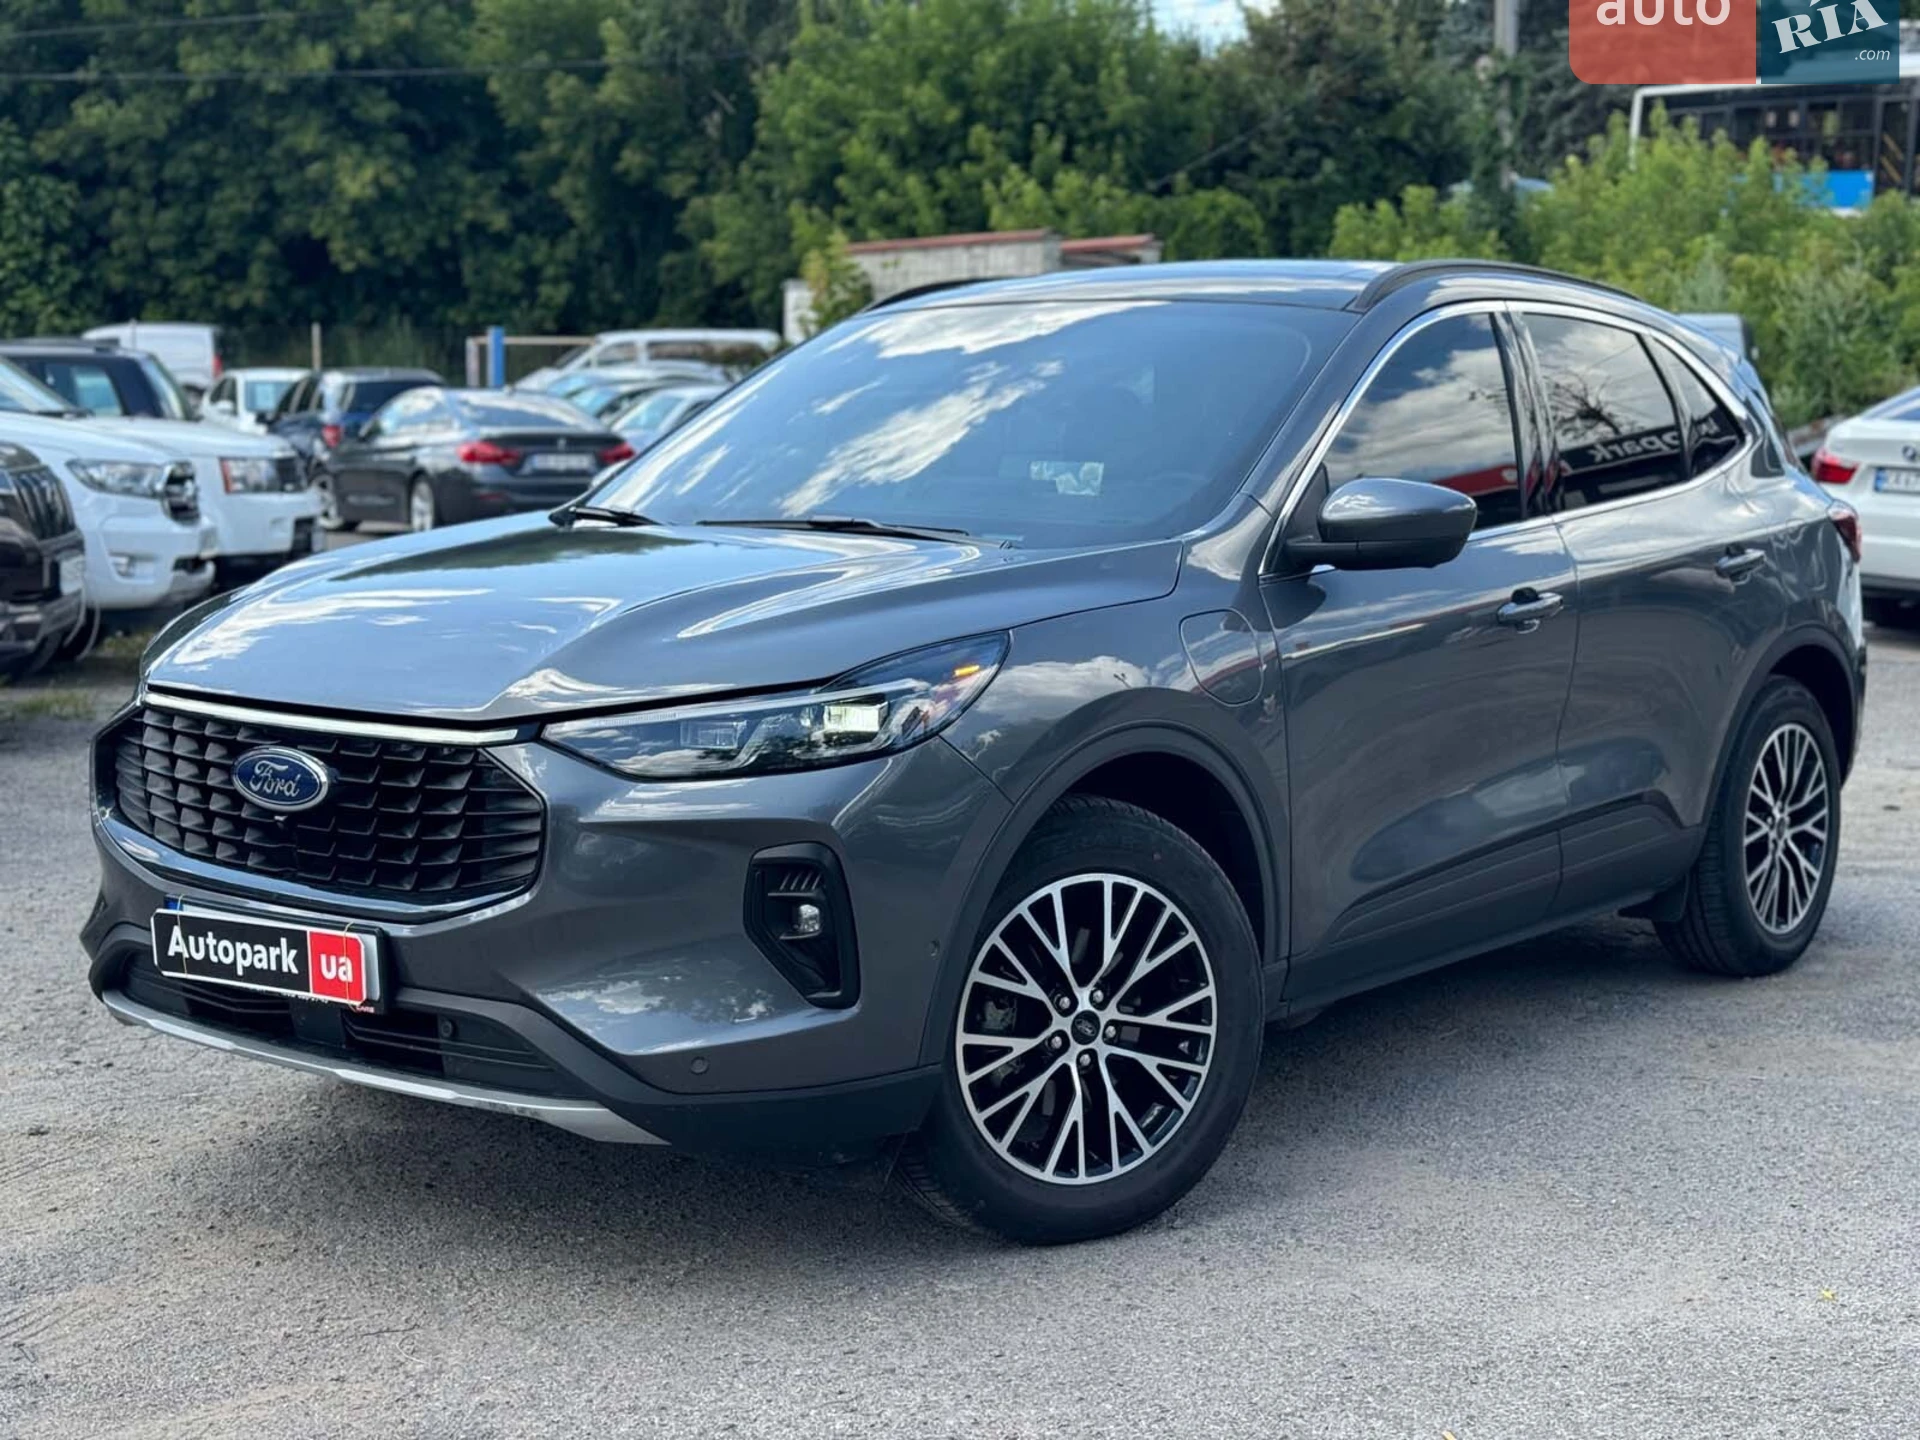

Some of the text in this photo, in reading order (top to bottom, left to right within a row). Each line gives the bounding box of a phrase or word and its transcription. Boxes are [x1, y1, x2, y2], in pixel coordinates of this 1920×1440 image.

[249, 760, 301, 797] Ford
[167, 925, 354, 983] Autopark ua
